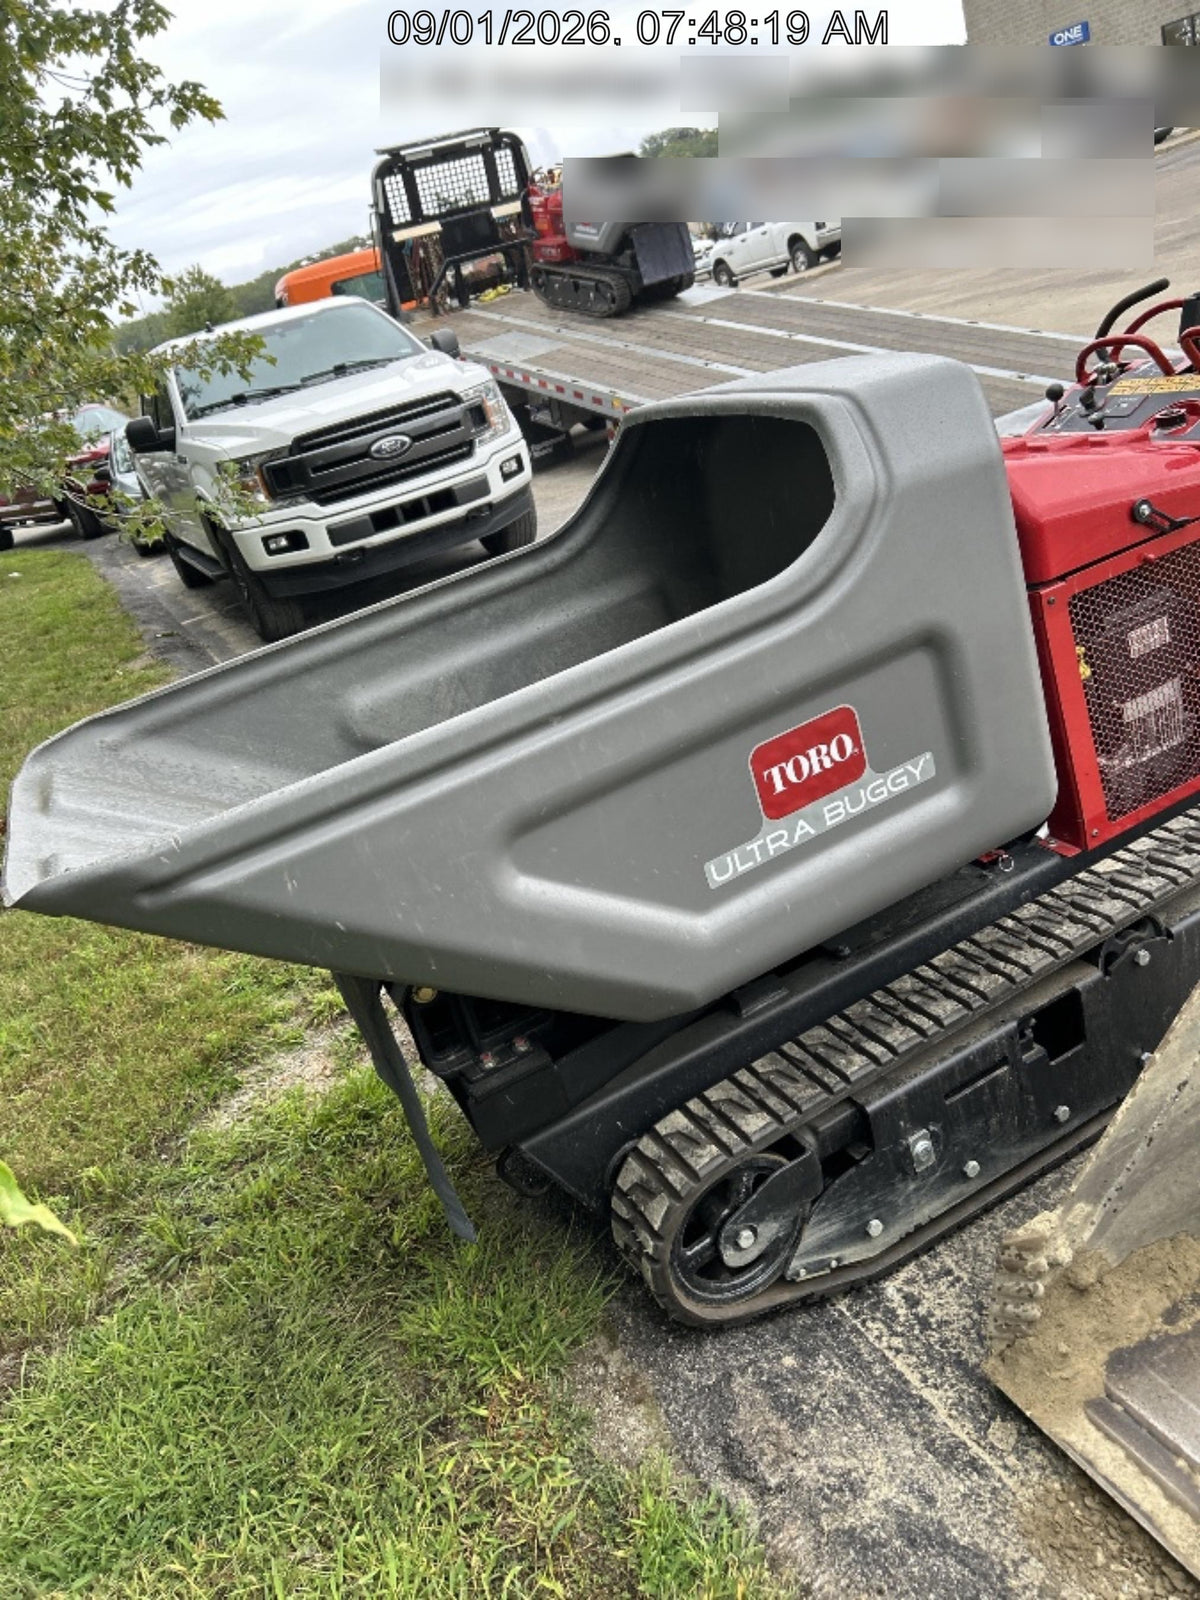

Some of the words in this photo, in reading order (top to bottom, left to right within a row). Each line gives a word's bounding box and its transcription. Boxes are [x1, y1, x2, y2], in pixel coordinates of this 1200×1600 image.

[1053, 24, 1082, 45] ONE
[763, 733, 856, 796] TORO
[710, 819, 816, 882] ULTRA
[823, 758, 928, 826] BUGGY
